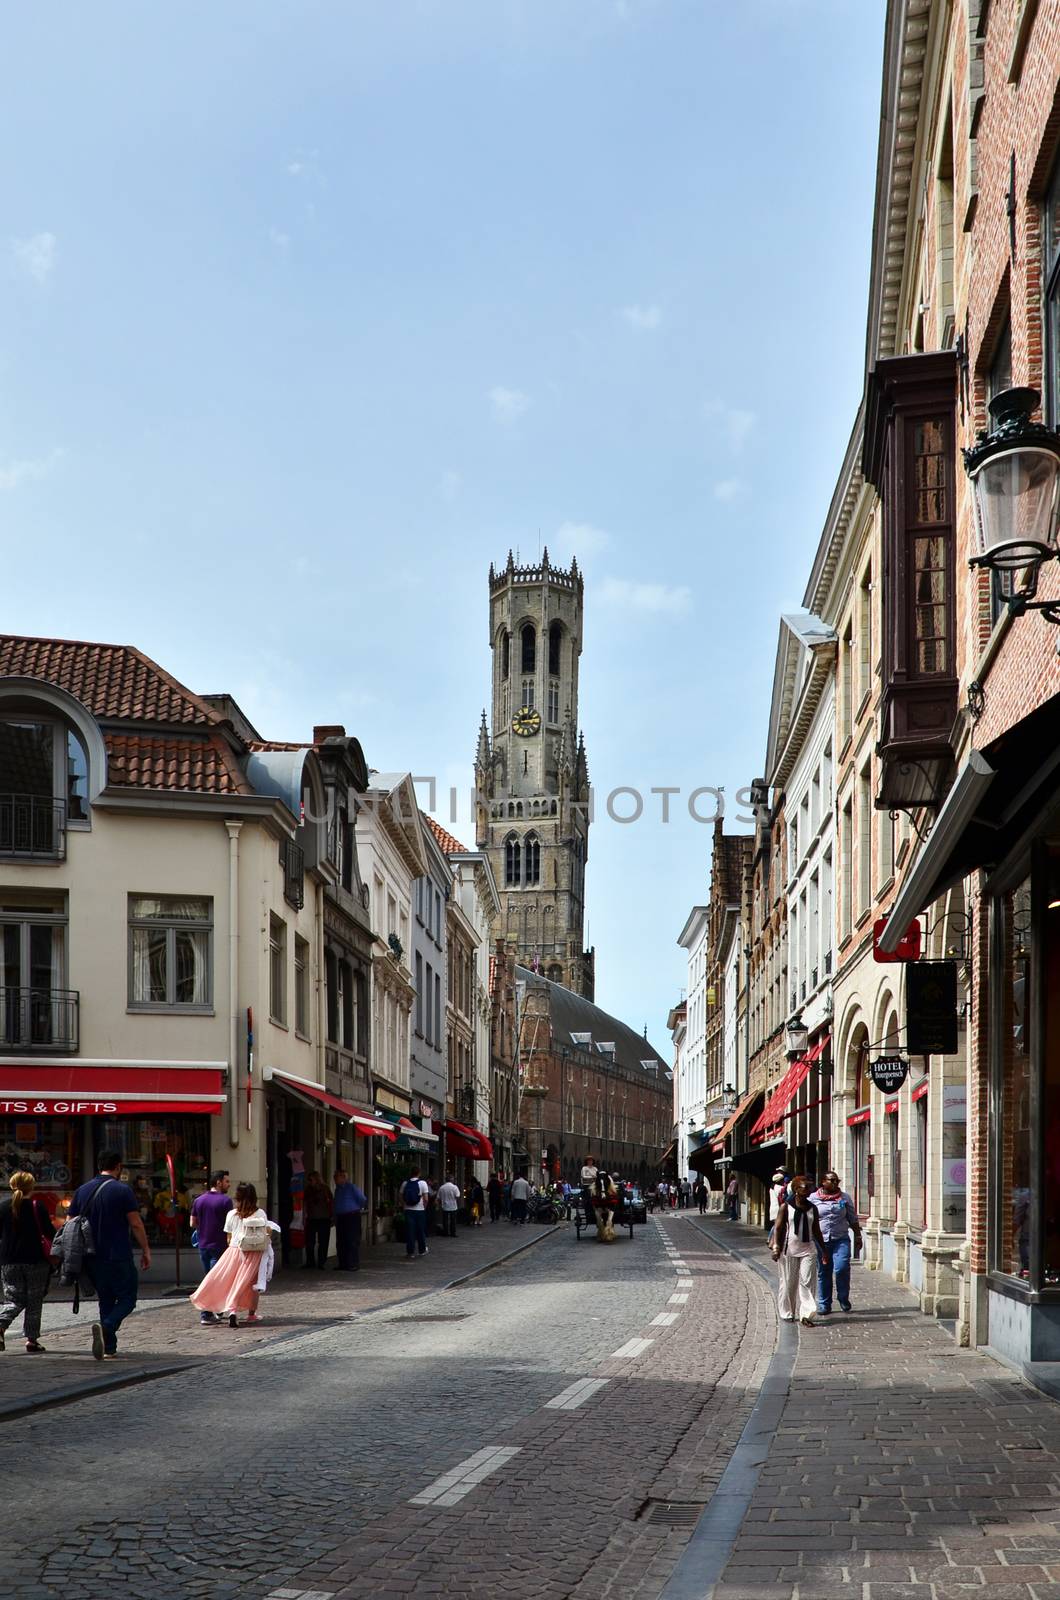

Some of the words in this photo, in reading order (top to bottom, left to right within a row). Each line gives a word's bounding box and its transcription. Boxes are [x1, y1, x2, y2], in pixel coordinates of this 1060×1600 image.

[873, 1061, 904, 1072] HOTEL
[32, 1101, 48, 1113] &
[53, 1101, 118, 1113] GIFTS
